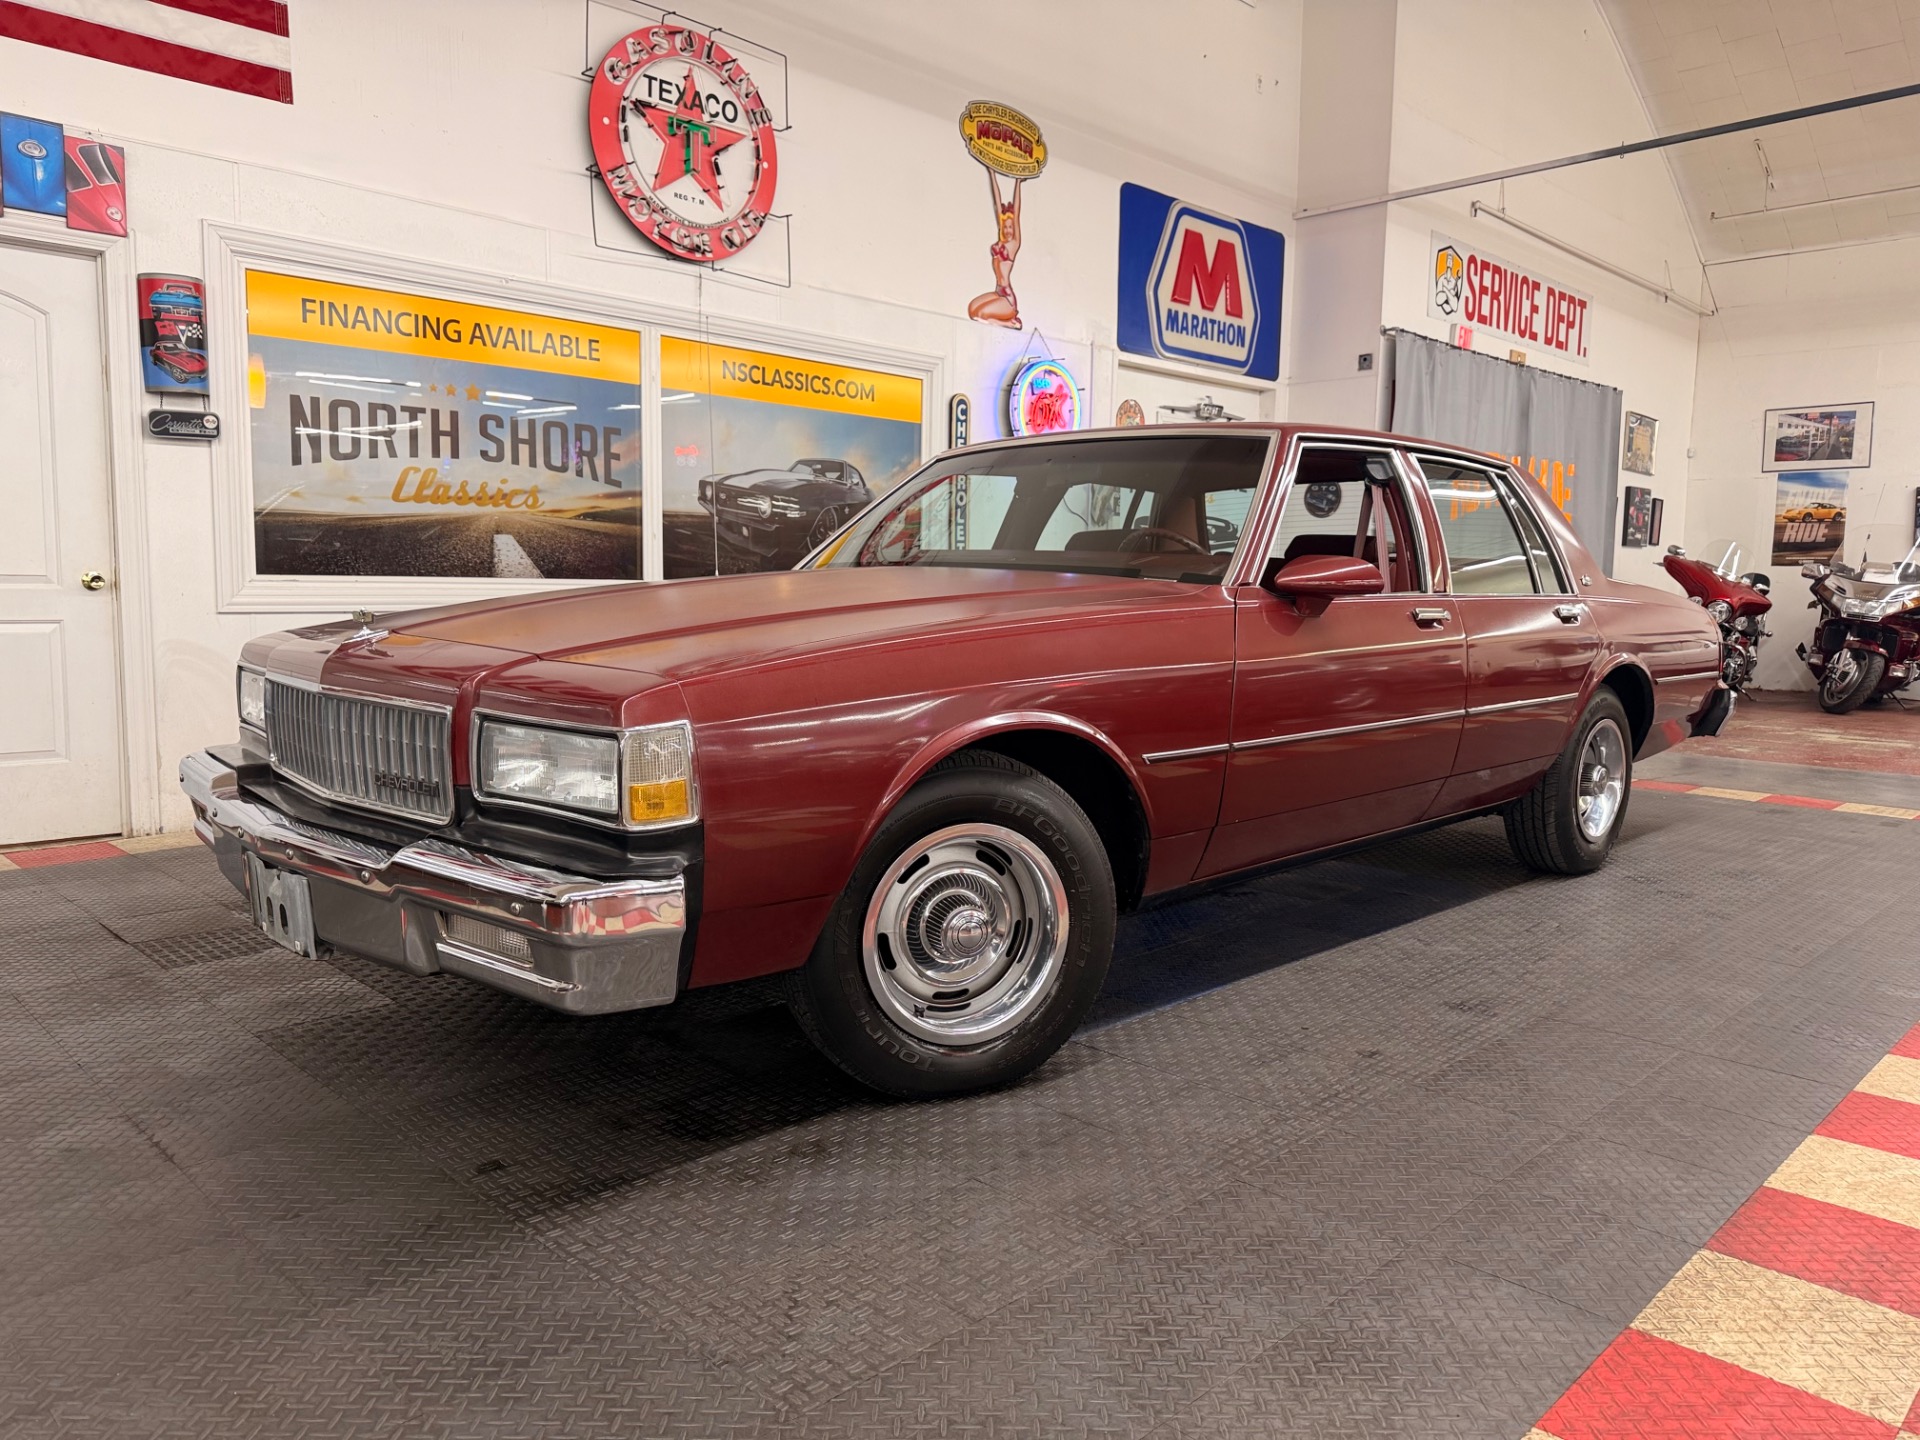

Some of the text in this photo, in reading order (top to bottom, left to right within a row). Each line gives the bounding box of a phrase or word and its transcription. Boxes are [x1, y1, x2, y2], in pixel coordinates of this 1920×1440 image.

[643, 73, 738, 124] TEXACO
[1171, 228, 1243, 320] M
[301, 297, 601, 362] FINANCING AVAILABLE
[1165, 308, 1246, 348] MARATHON
[1464, 254, 1588, 358] SERVICE DEPT.
[722, 360, 875, 402] NSCLASSICS.COM
[289, 394, 623, 489] NORTH SHORE
[391, 465, 545, 510] Classics
[1782, 522, 1831, 543] RIDE
[374, 772, 440, 798] CHEVROLET
